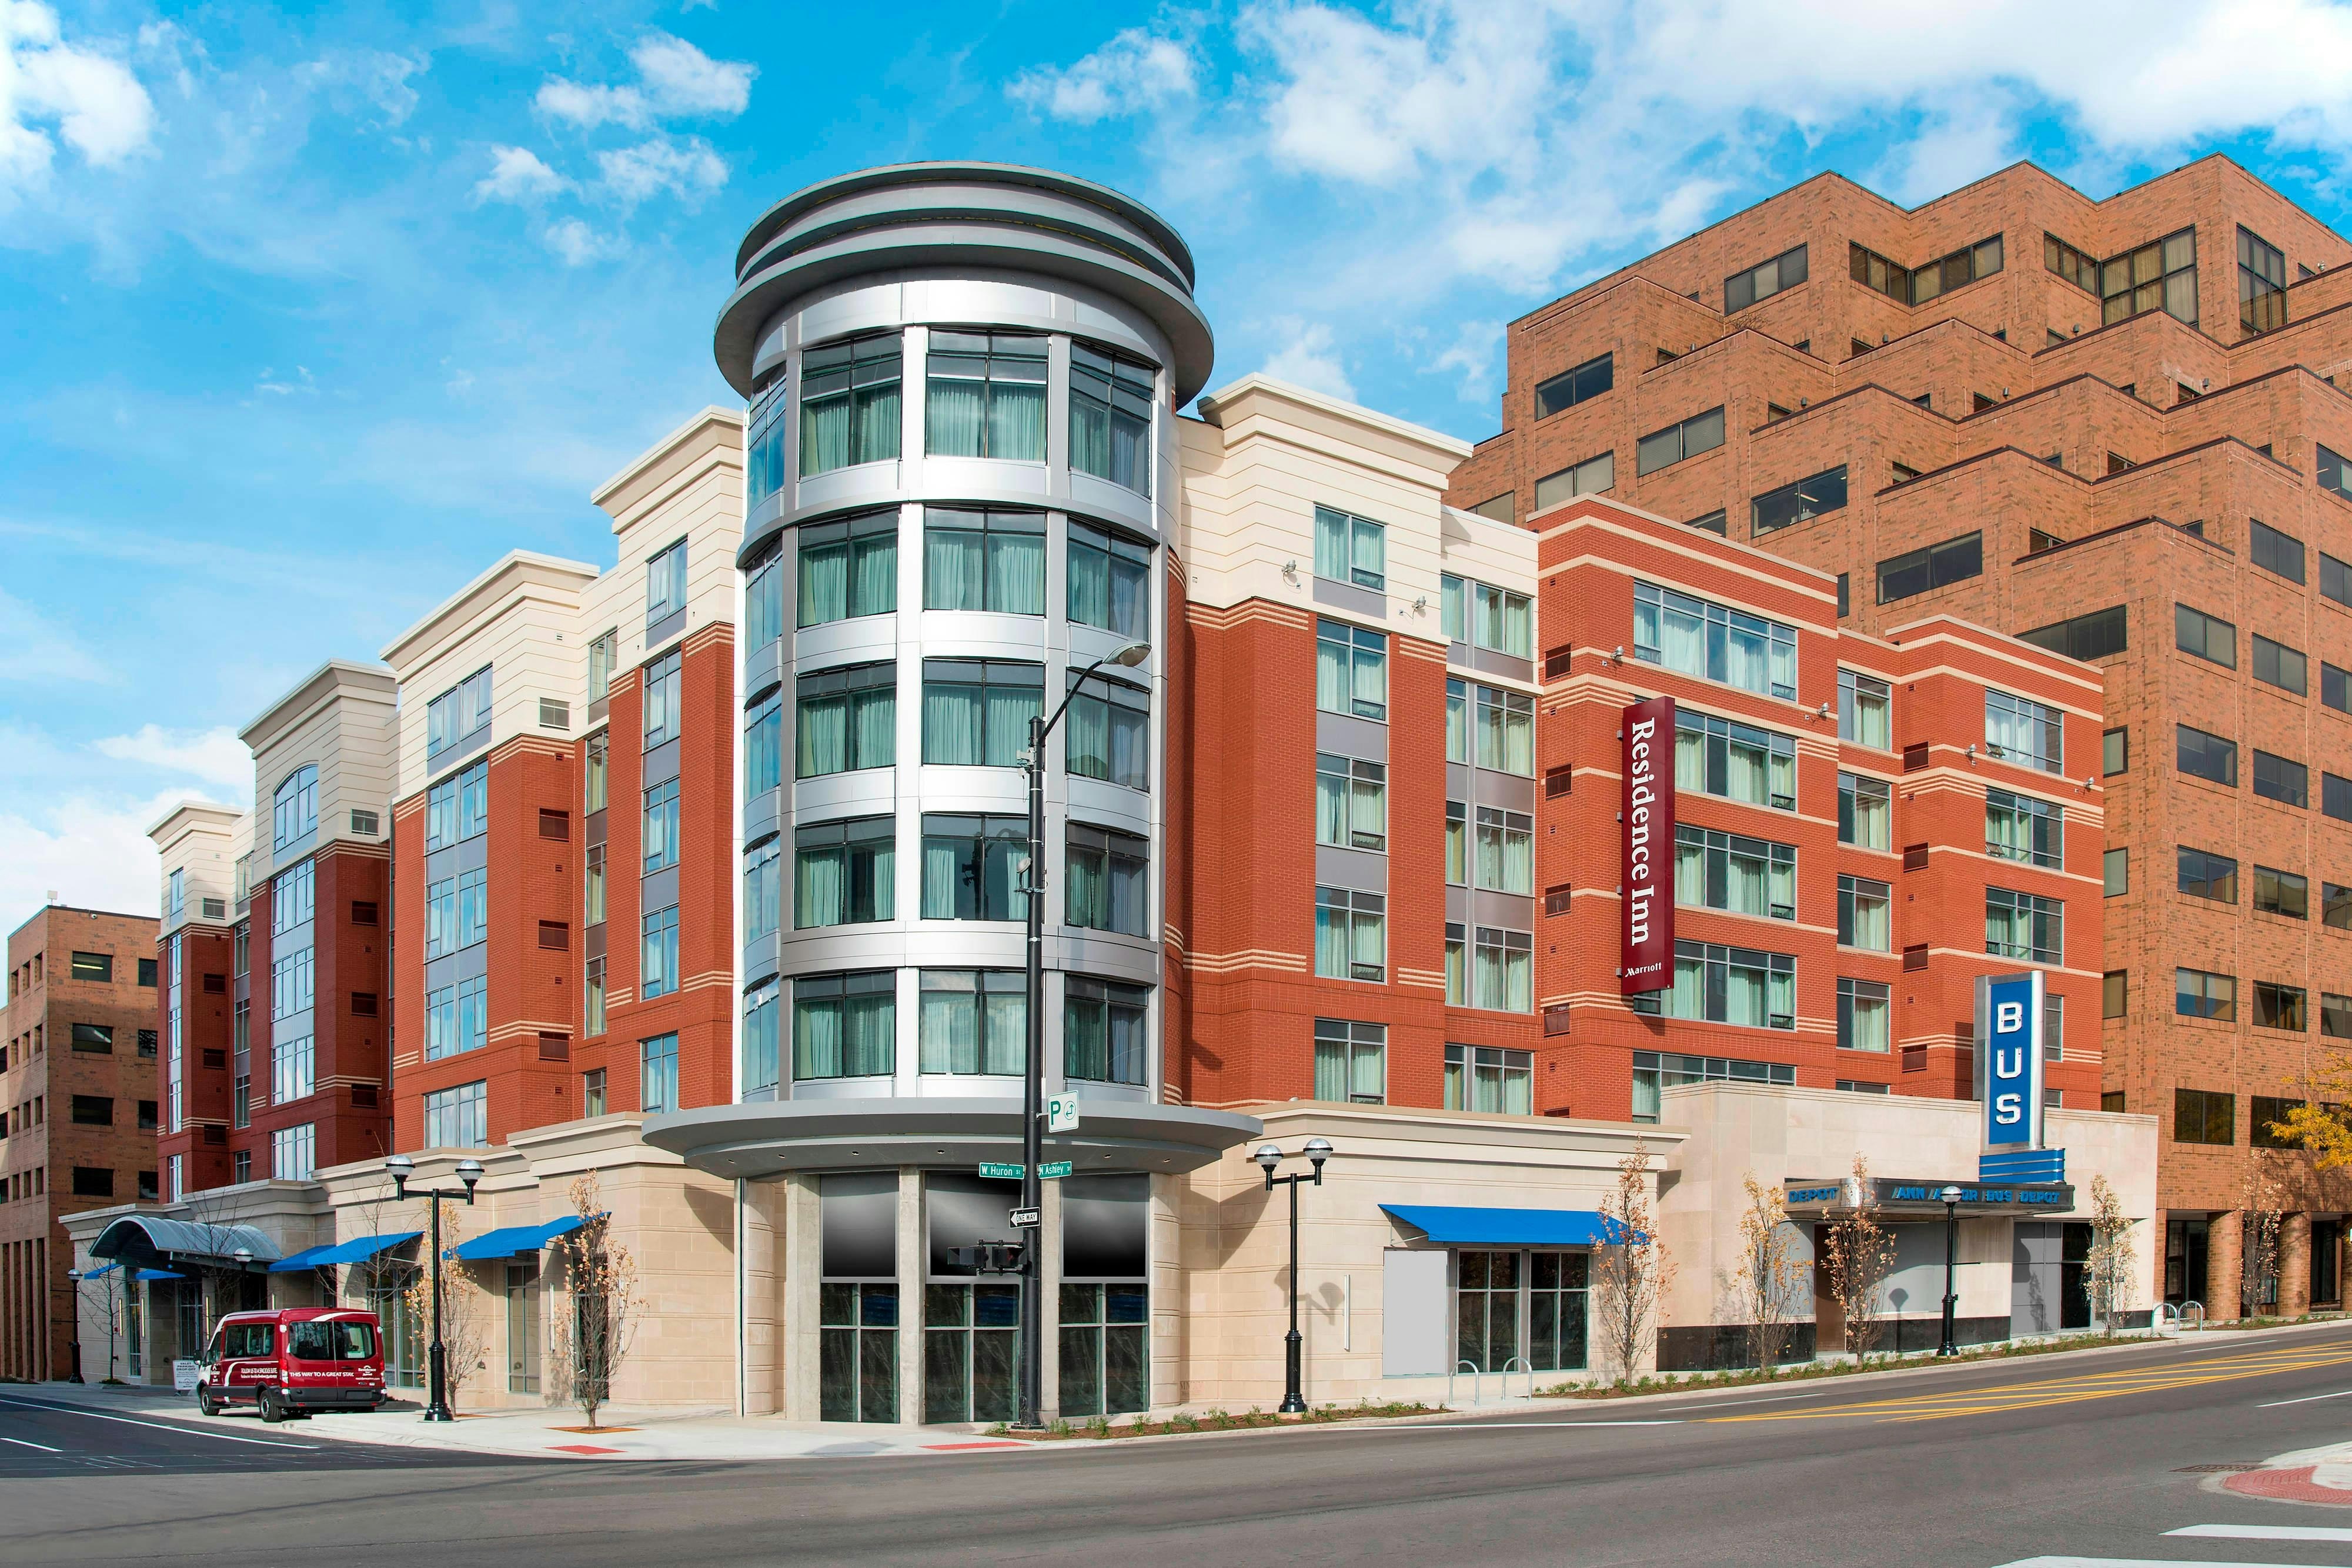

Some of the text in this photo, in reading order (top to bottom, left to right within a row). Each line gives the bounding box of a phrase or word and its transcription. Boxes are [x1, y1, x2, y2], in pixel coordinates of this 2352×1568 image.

[1631, 717, 1655, 947] Residence Inn
[1625, 962, 1662, 978] Marriott
[1996, 1001, 2023, 1125] BUS
[1050, 1100, 1061, 1125] P
[991, 1166, 1013, 1176] Huron
[1039, 1166, 1044, 1175] N
[1045, 1165, 1063, 1175] Ashley
[1788, 1187, 1839, 1203] DEPOT
[1895, 1186, 2061, 1203] ANN AOR BUS DEPOT
